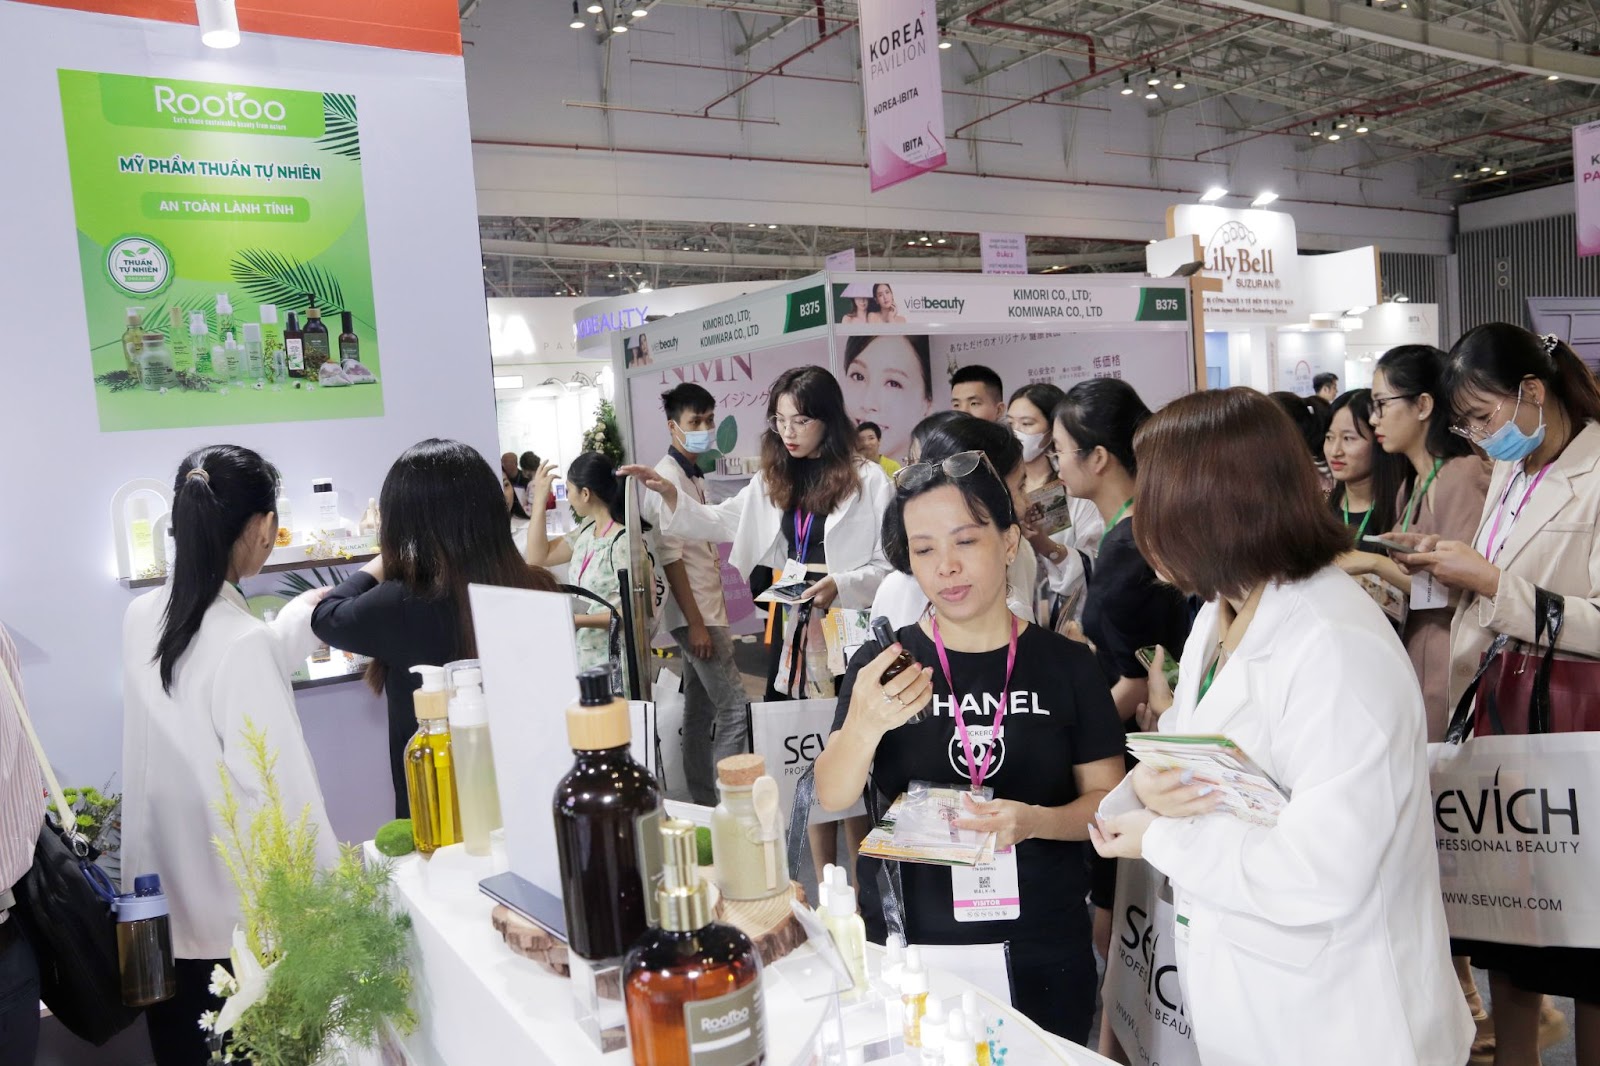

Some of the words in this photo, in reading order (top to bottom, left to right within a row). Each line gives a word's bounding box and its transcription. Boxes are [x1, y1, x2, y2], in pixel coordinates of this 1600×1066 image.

[870, 18, 924, 62] KOREA
[871, 39, 926, 80] PAVILION
[874, 87, 918, 116] KOREA-IBITA
[903, 136, 923, 153] IBITA
[120, 155, 144, 172] MỸ
[254, 162, 273, 181] TỰ
[277, 164, 321, 180] NHIÊN
[159, 200, 179, 212] AN
[183, 199, 220, 213] TOÀN
[224, 201, 260, 214] LÀNH
[263, 201, 294, 215] TÍNH
[1013, 289, 1050, 301] KIMORI
[1052, 289, 1071, 302] CO.,
[1072, 289, 1092, 302] LTD;
[800, 300, 821, 317] B375
[904, 296, 965, 315] vietbeauty
[1008, 306, 1064, 318] KOMIWARA
[1066, 306, 1085, 319] CO.,
[1086, 306, 1103, 317] LTD
[1156, 299, 1179, 311] B375
[702, 315, 723, 332] KIMORI
[724, 313, 736, 327] CO.,
[700, 331, 733, 348] KOMIWARA
[734, 328, 746, 342] CO.,
[747, 324, 760, 337] LTD
[1430, 764, 1580, 835] EVICH
[1517, 840, 1580, 854] BEAUTY
[972, 899, 1001, 907] VISITOR
